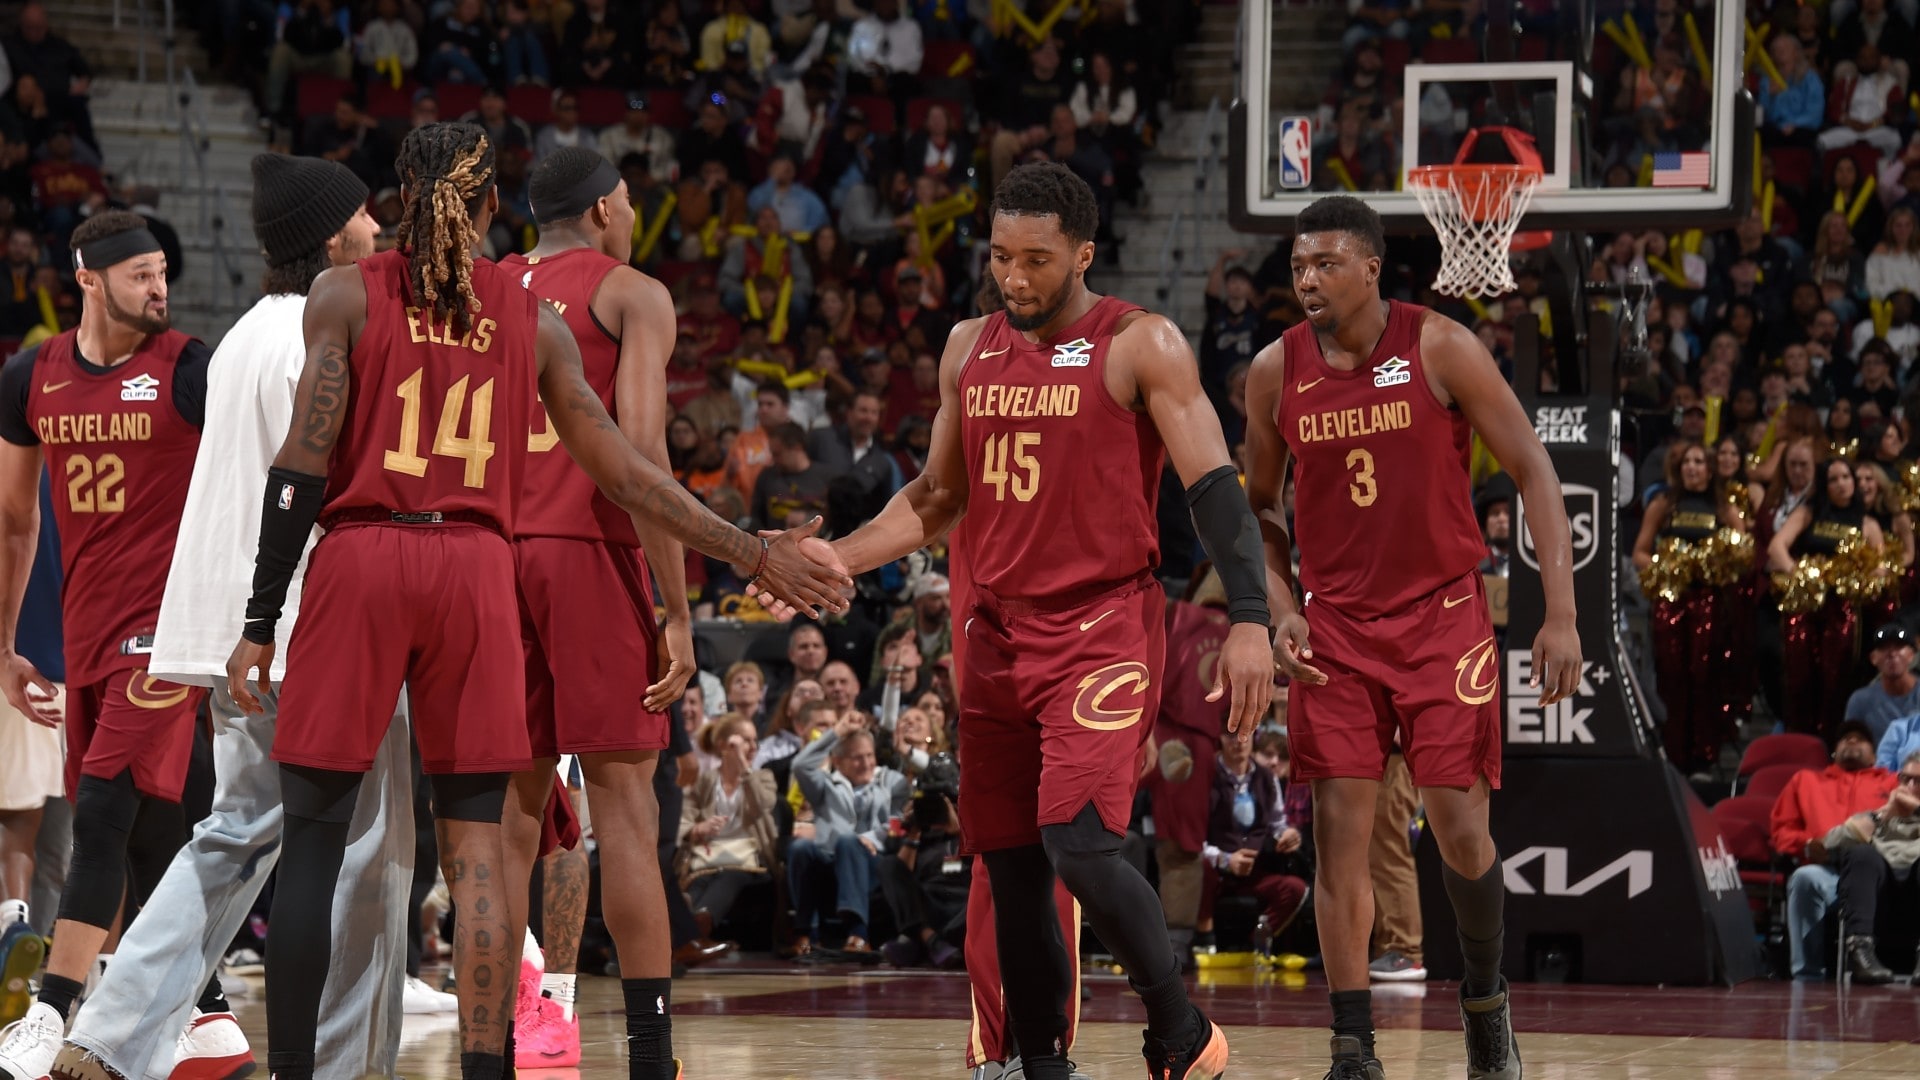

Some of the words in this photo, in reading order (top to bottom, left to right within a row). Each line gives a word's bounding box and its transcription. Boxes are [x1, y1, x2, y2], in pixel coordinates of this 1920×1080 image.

[1053, 356, 1088, 364] CLIFFS
[1375, 373, 1409, 385] CLIFFS
[966, 384, 1081, 418] CLEVELAND
[1298, 400, 1412, 443] CLEVELAND
[1536, 406, 1588, 425] SEAT
[37, 412, 152, 444] CLEVELAND
[383, 366, 496, 489] 14
[65, 452, 126, 513] 22
[982, 431, 1041, 502] 45
[1345, 448, 1378, 508] 3
[1507, 696, 1597, 744] Elk
